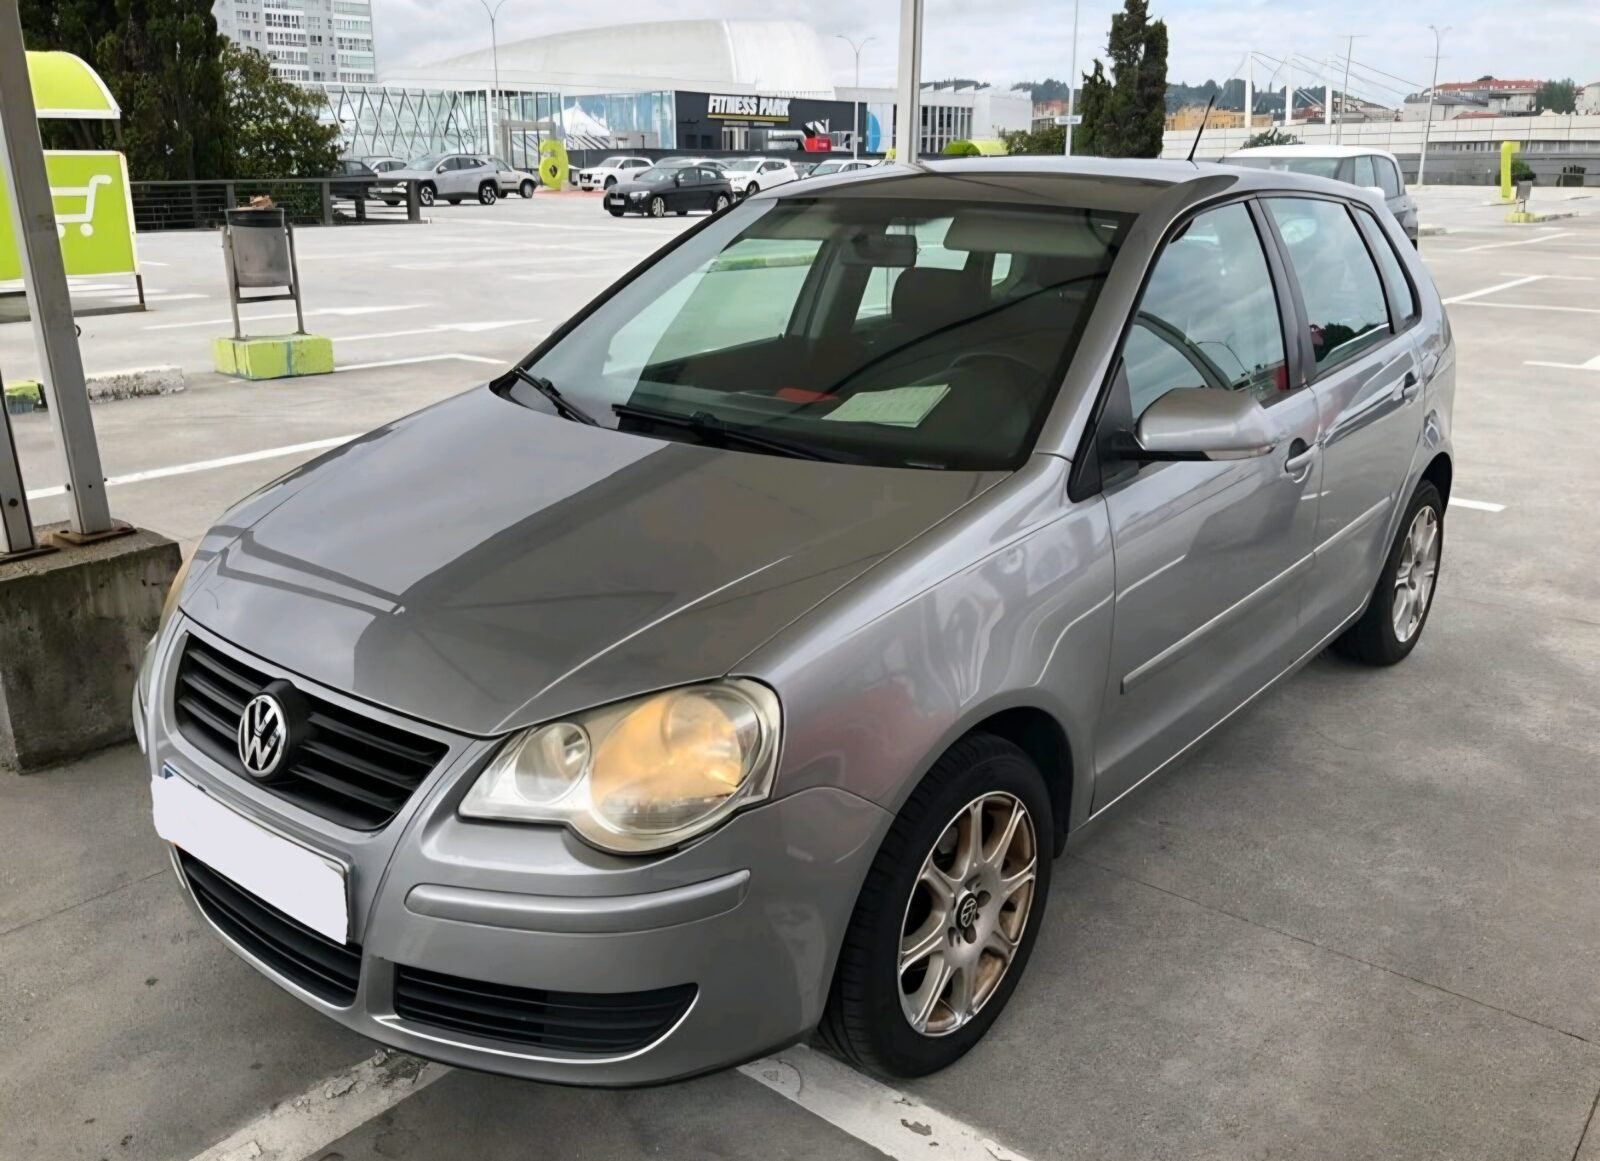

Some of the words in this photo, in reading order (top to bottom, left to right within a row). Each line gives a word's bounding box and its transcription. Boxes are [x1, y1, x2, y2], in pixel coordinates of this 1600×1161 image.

[708, 94, 758, 116] FITNESS
[759, 97, 790, 117] PARK
[238, 695, 287, 778] VW
